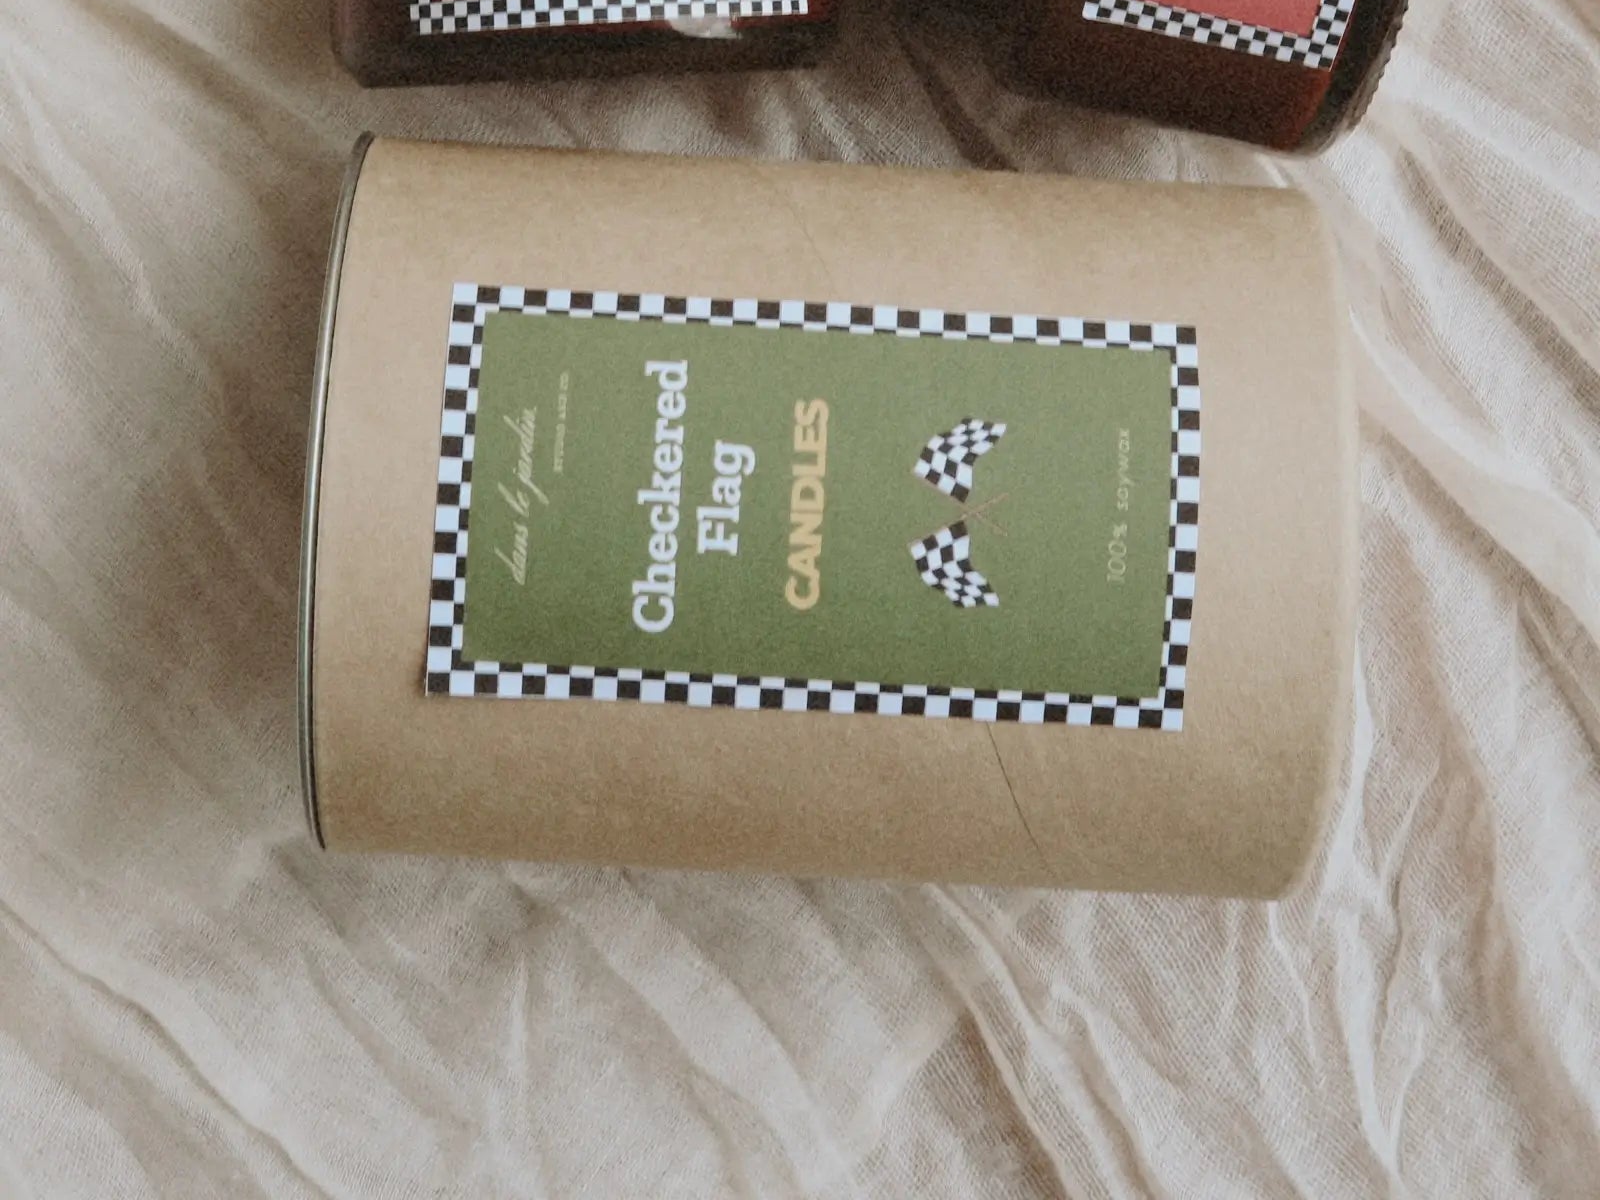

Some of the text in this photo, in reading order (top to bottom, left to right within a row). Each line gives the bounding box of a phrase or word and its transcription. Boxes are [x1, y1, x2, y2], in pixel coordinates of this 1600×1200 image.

[493, 520, 530, 586] dans
[497, 482, 530, 518] le
[632, 360, 690, 634] Checkered
[696, 439, 755, 557] Flag
[783, 398, 829, 611] CANDLES
[1106, 427, 1136, 584] 100% soywax
